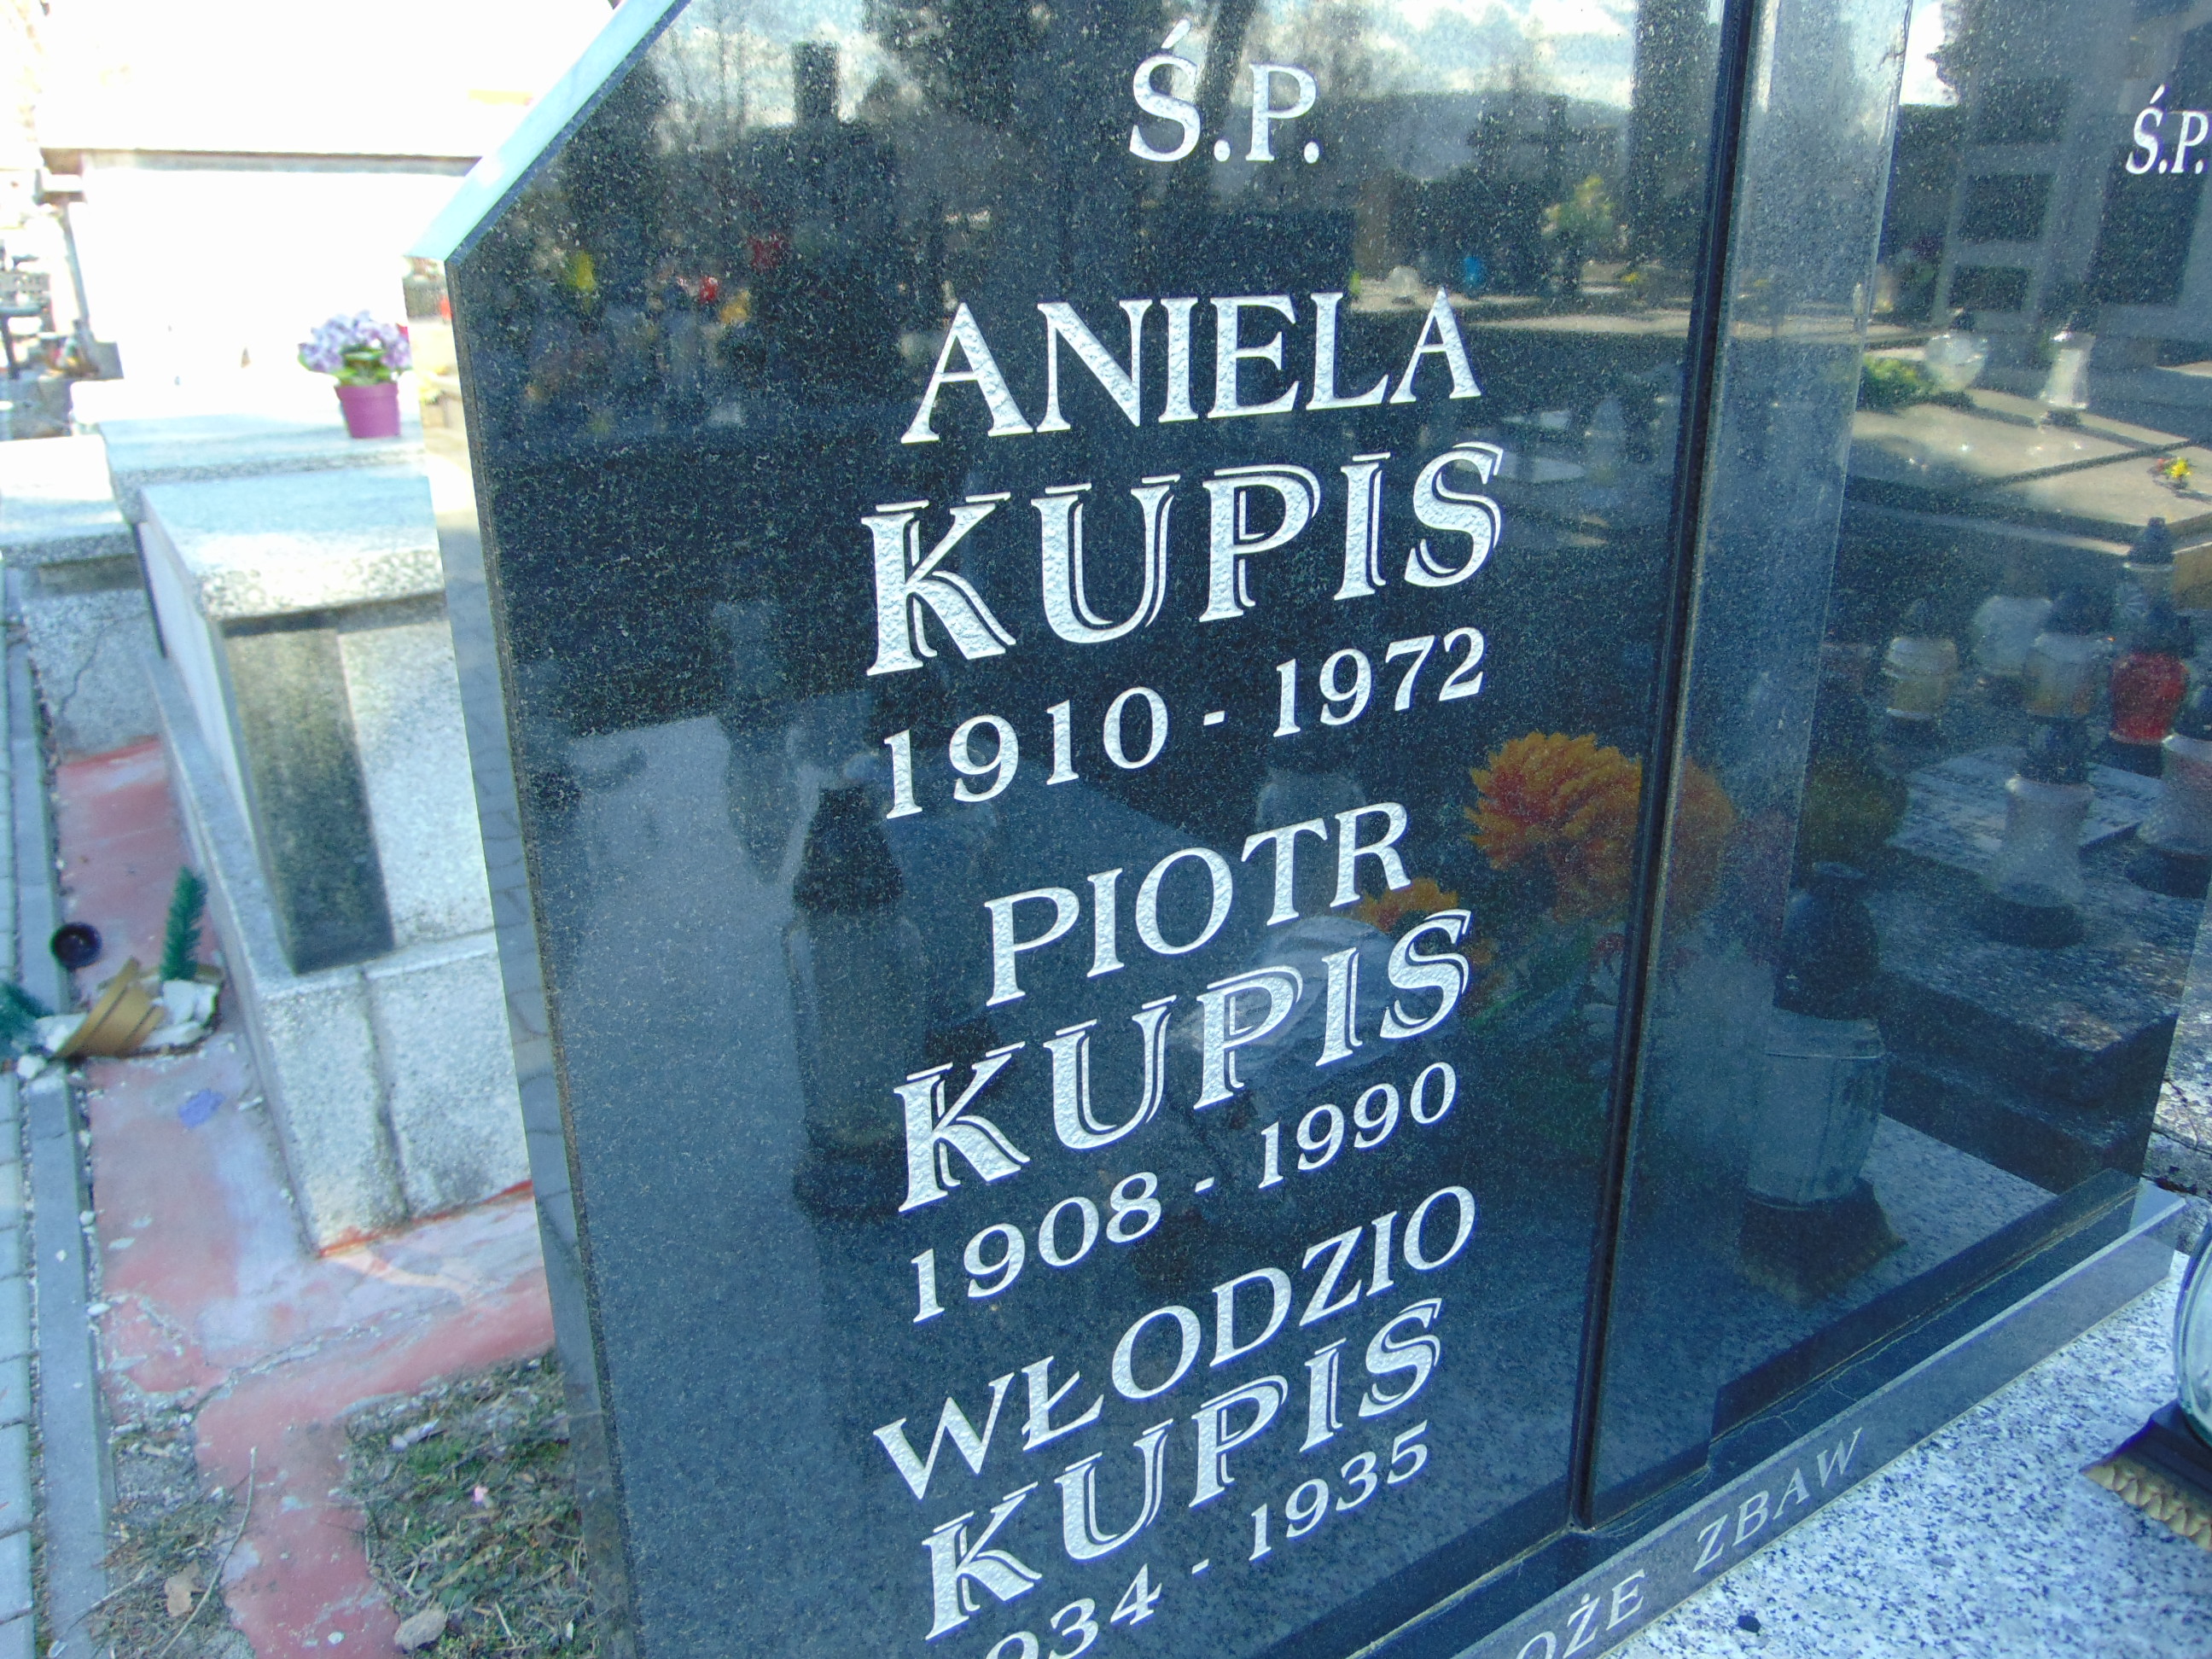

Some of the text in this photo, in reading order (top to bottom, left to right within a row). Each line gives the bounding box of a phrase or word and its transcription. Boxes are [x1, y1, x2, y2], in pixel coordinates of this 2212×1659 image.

[1129, 19, 1320, 163] Ś.P.
[2125, 84, 2209, 174] Ś.P.
[901, 287, 1481, 444] ANIELA
[861, 441, 1504, 677] KUPIS
[884, 626, 1485, 819] 1910 - 1972
[984, 801, 1412, 1006] PIOTR
[894, 909, 1472, 1213] KUPIS
[911, 1062, 1458, 1324] 1908 - 1990
[873, 1185, 1476, 1500] WŁODZIO
[922, 1297, 1442, 1640] KUPIS
[1249, 1419, 1429, 1562] 1935
[1692, 1427, 1863, 1573] ZBAW
